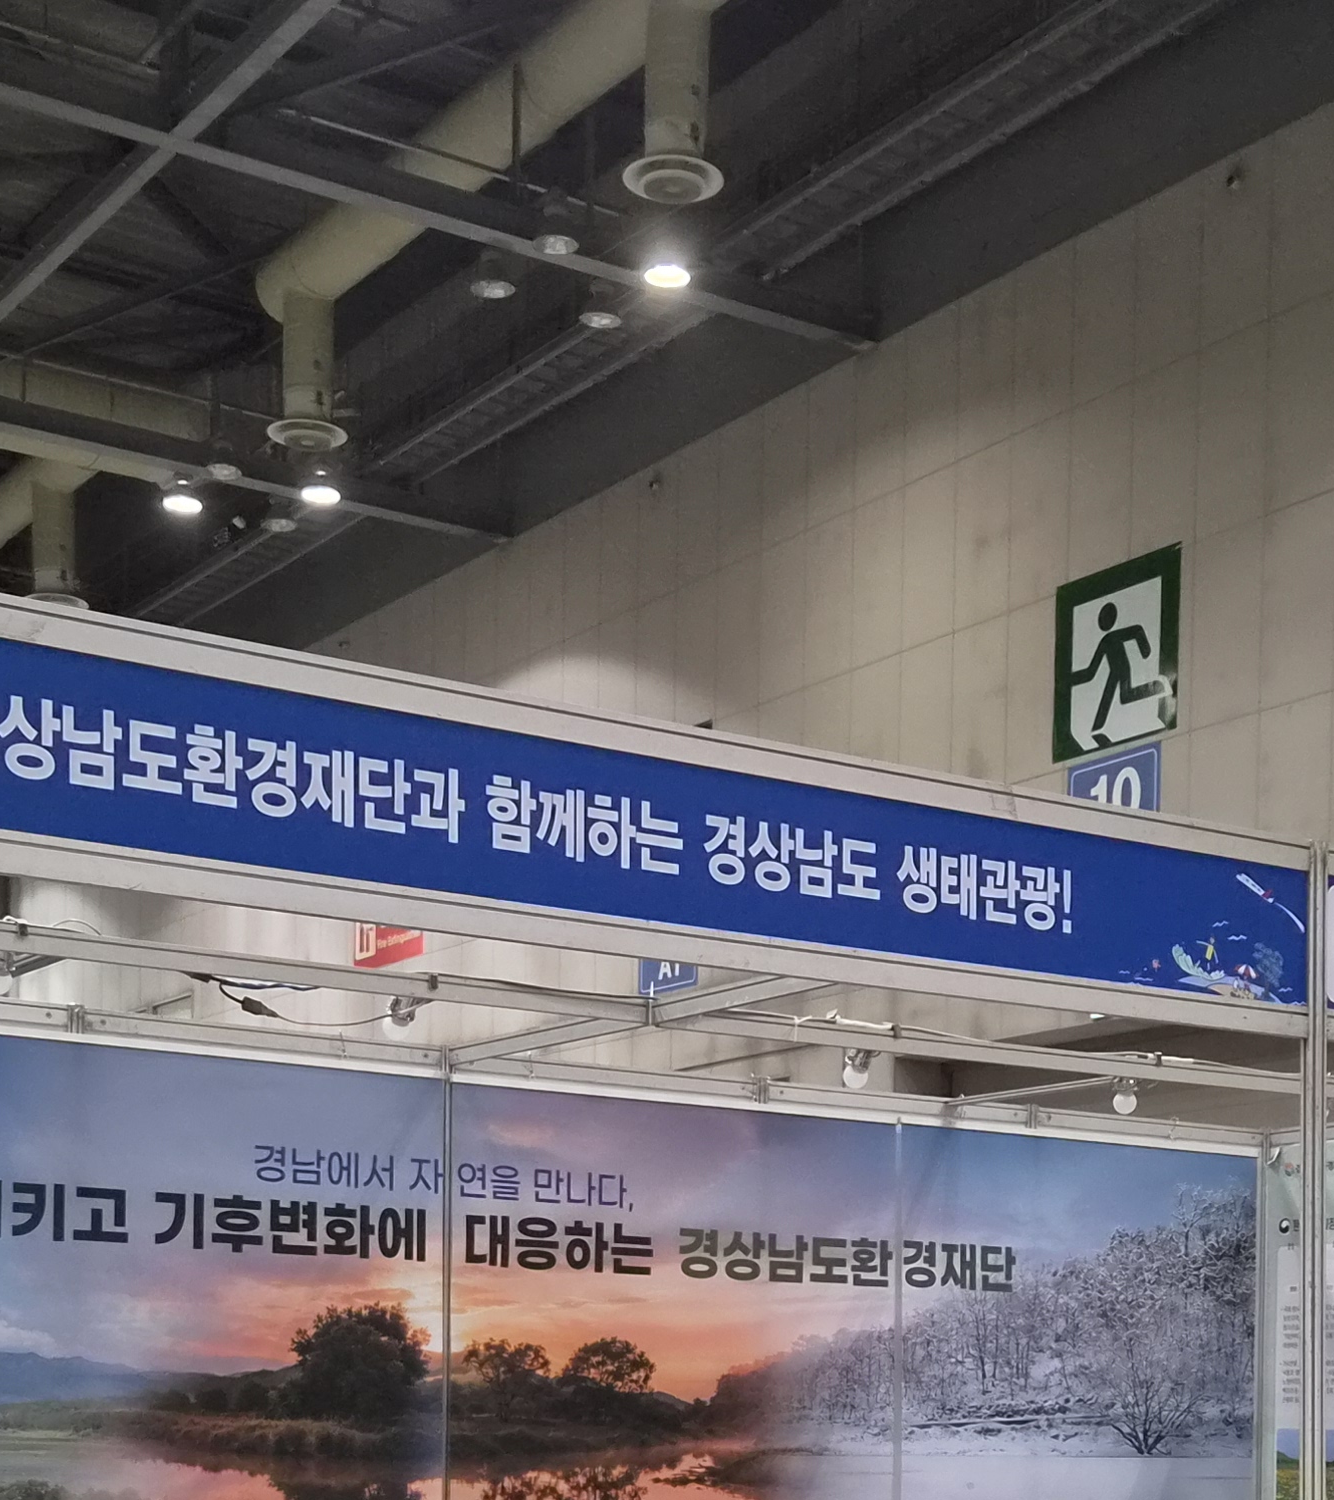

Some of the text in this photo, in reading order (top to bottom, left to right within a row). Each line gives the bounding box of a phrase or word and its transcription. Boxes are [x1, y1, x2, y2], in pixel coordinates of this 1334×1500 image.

[1090, 766, 1142, 810] 10
[484, 775, 684, 875] 함께하는
[703, 812, 881, 901] 경상남도
[896, 843, 1073, 934] 생태관광!
[253, 1144, 395, 1193] 경남에서
[532, 1166, 635, 1213] 만나다,
[154, 1191, 428, 1263] 기후변화에
[464, 1213, 655, 1276] 대응하는
[677, 1226, 1017, 1293] 경상남도환경재단
